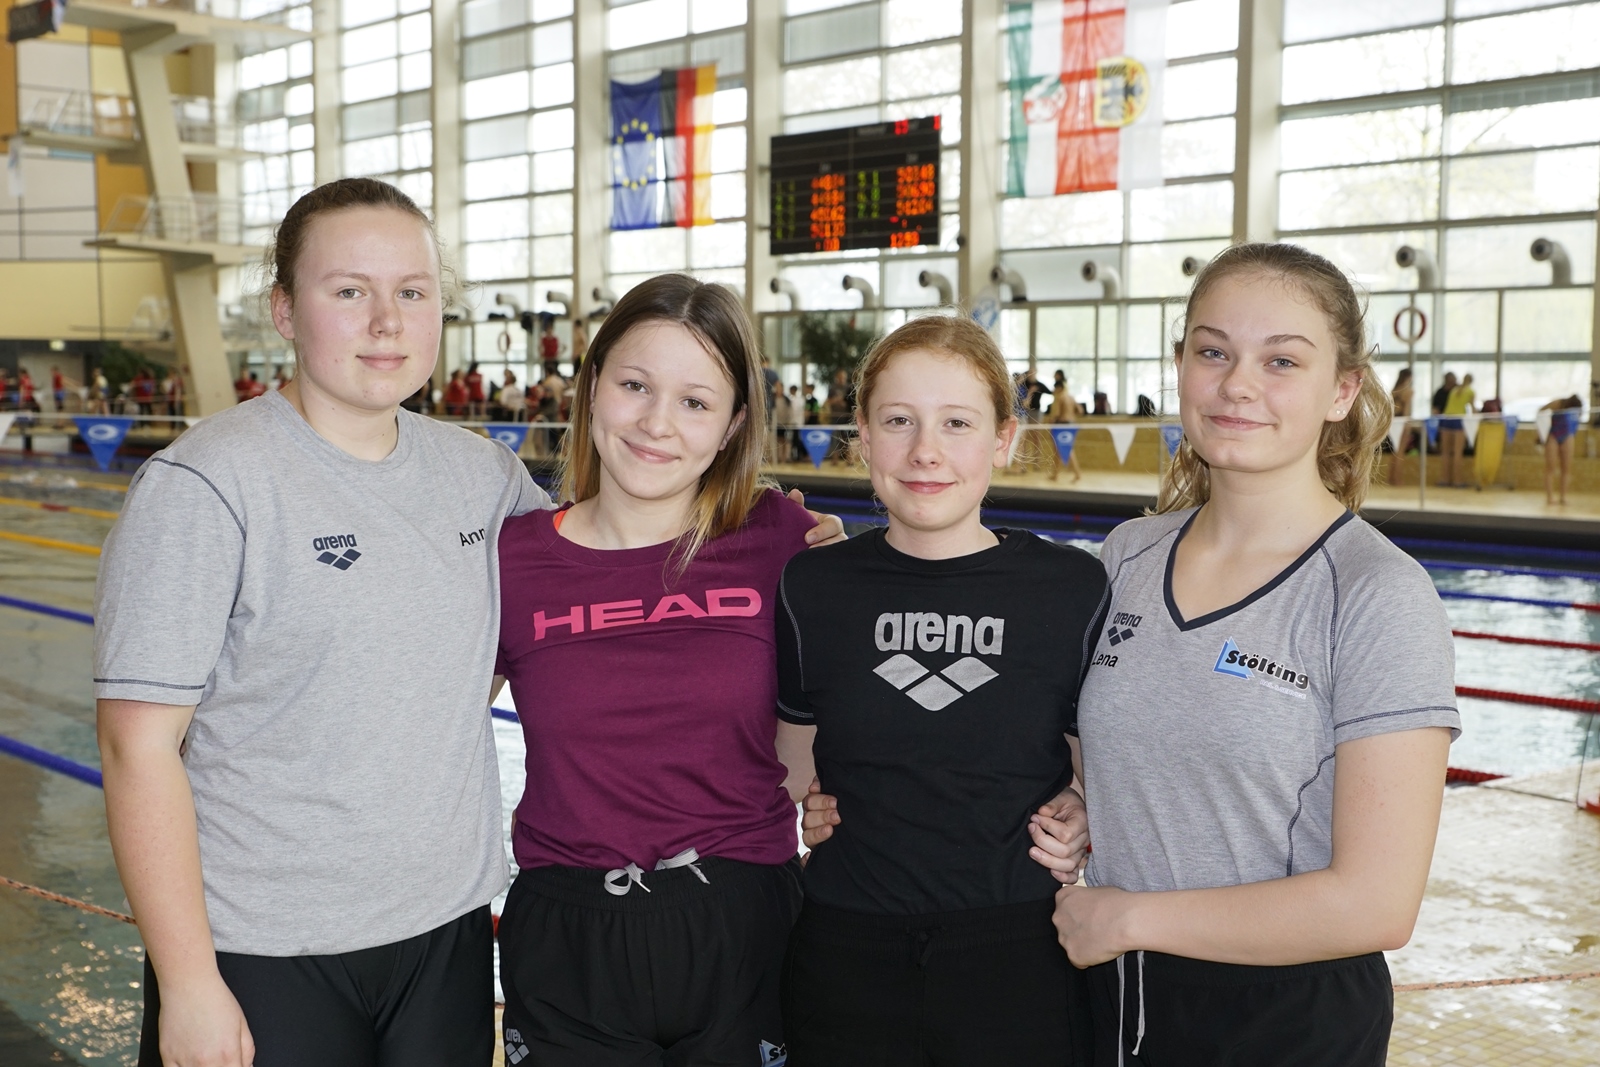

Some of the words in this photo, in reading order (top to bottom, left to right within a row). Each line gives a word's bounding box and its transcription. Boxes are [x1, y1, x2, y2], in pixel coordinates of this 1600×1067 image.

[312, 533, 358, 552] arena
[532, 587, 763, 641] HEAD
[1113, 612, 1143, 628] arena
[874, 611, 1005, 656] arena
[1091, 651, 1119, 668] Lena
[1225, 650, 1309, 690] Stölting
